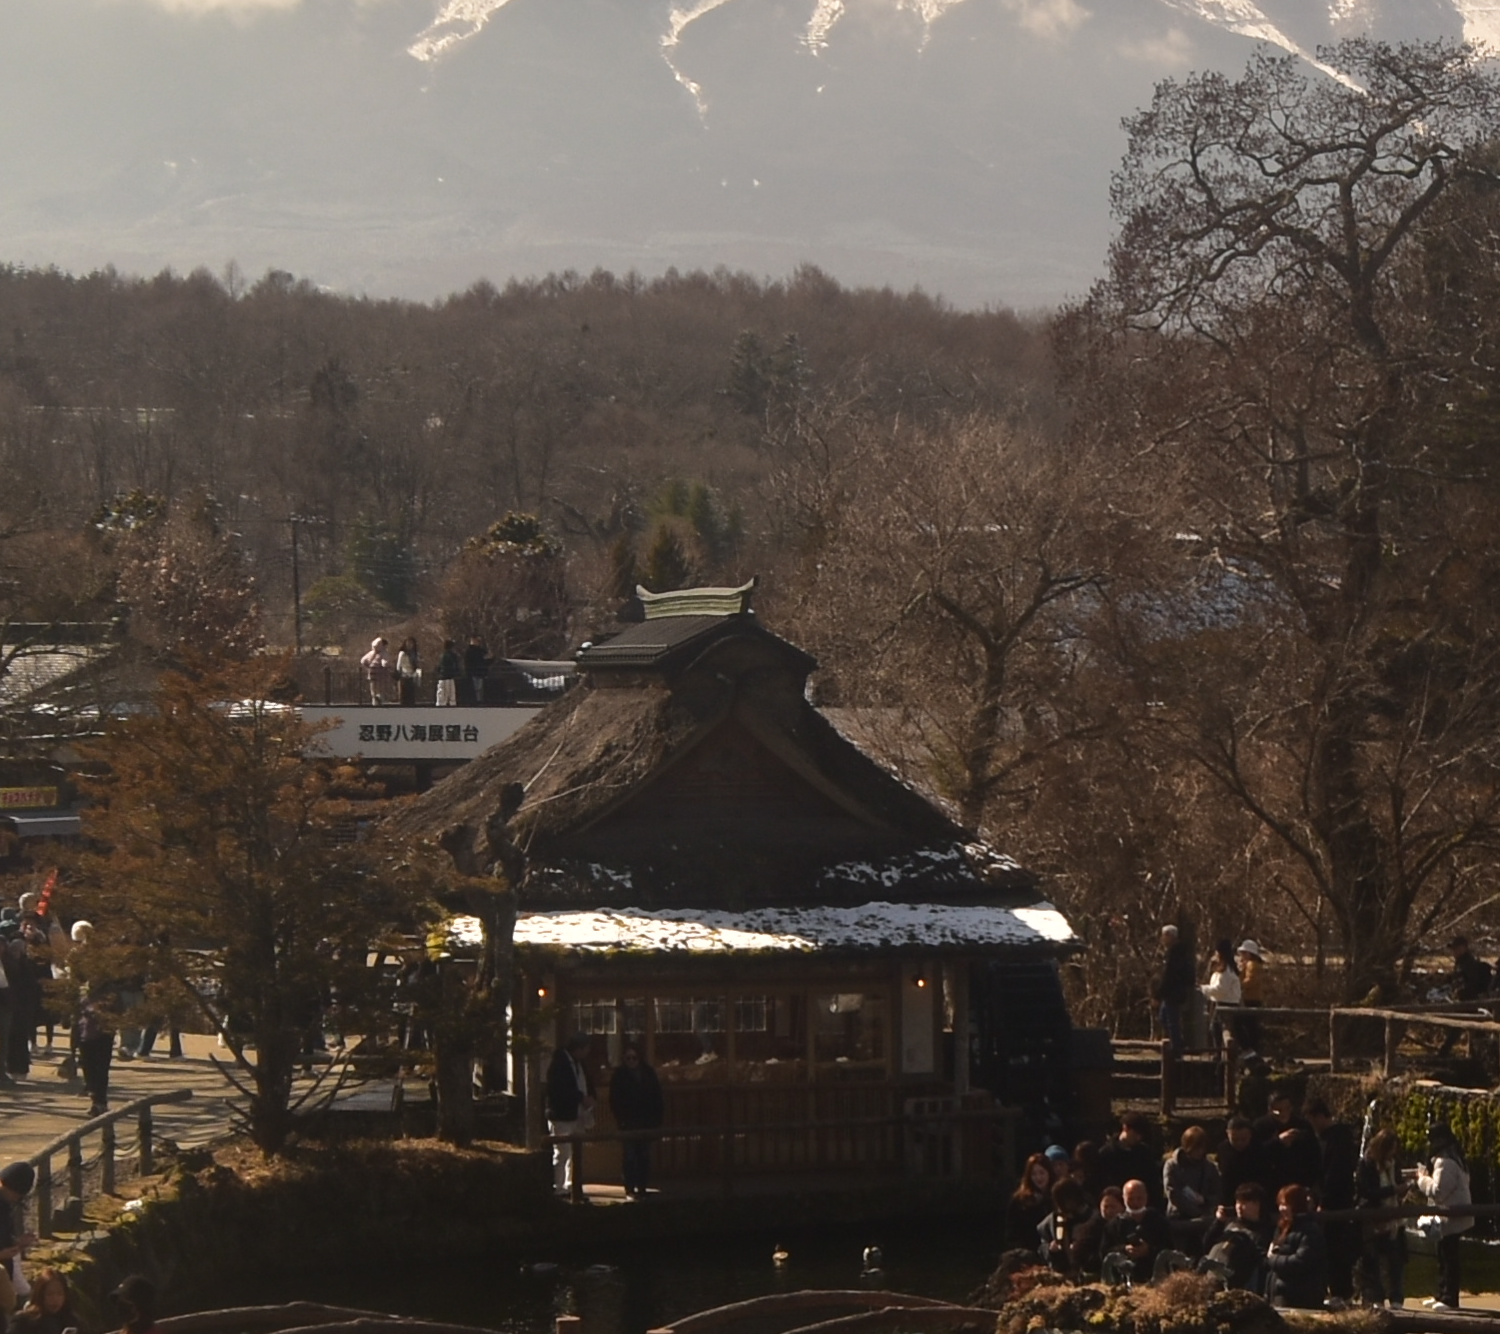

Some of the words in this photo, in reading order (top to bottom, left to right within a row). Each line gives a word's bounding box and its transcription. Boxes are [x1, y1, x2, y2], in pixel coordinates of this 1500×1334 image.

[359, 724, 479, 742] 忍野八海展望台
